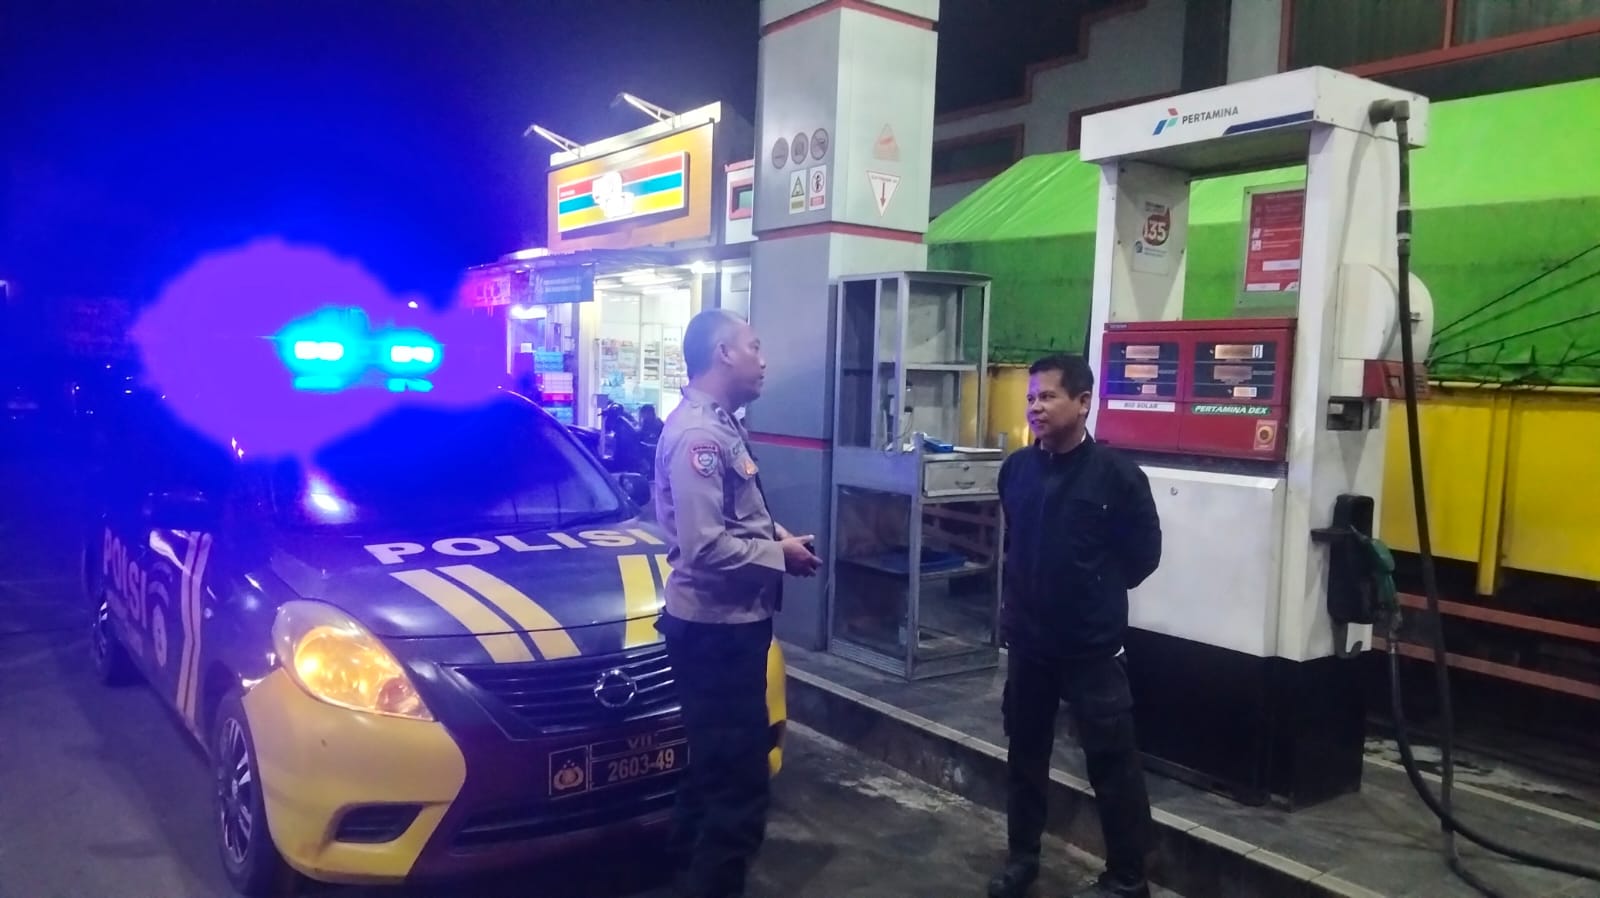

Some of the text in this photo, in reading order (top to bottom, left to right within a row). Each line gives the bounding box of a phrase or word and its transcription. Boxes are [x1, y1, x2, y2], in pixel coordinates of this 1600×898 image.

[1182, 106, 1239, 125] PERTAMINA
[1194, 405, 1268, 415] PERTAMINA DEX
[363, 528, 665, 565] POLISI
[607, 748, 675, 782] 2603-49
